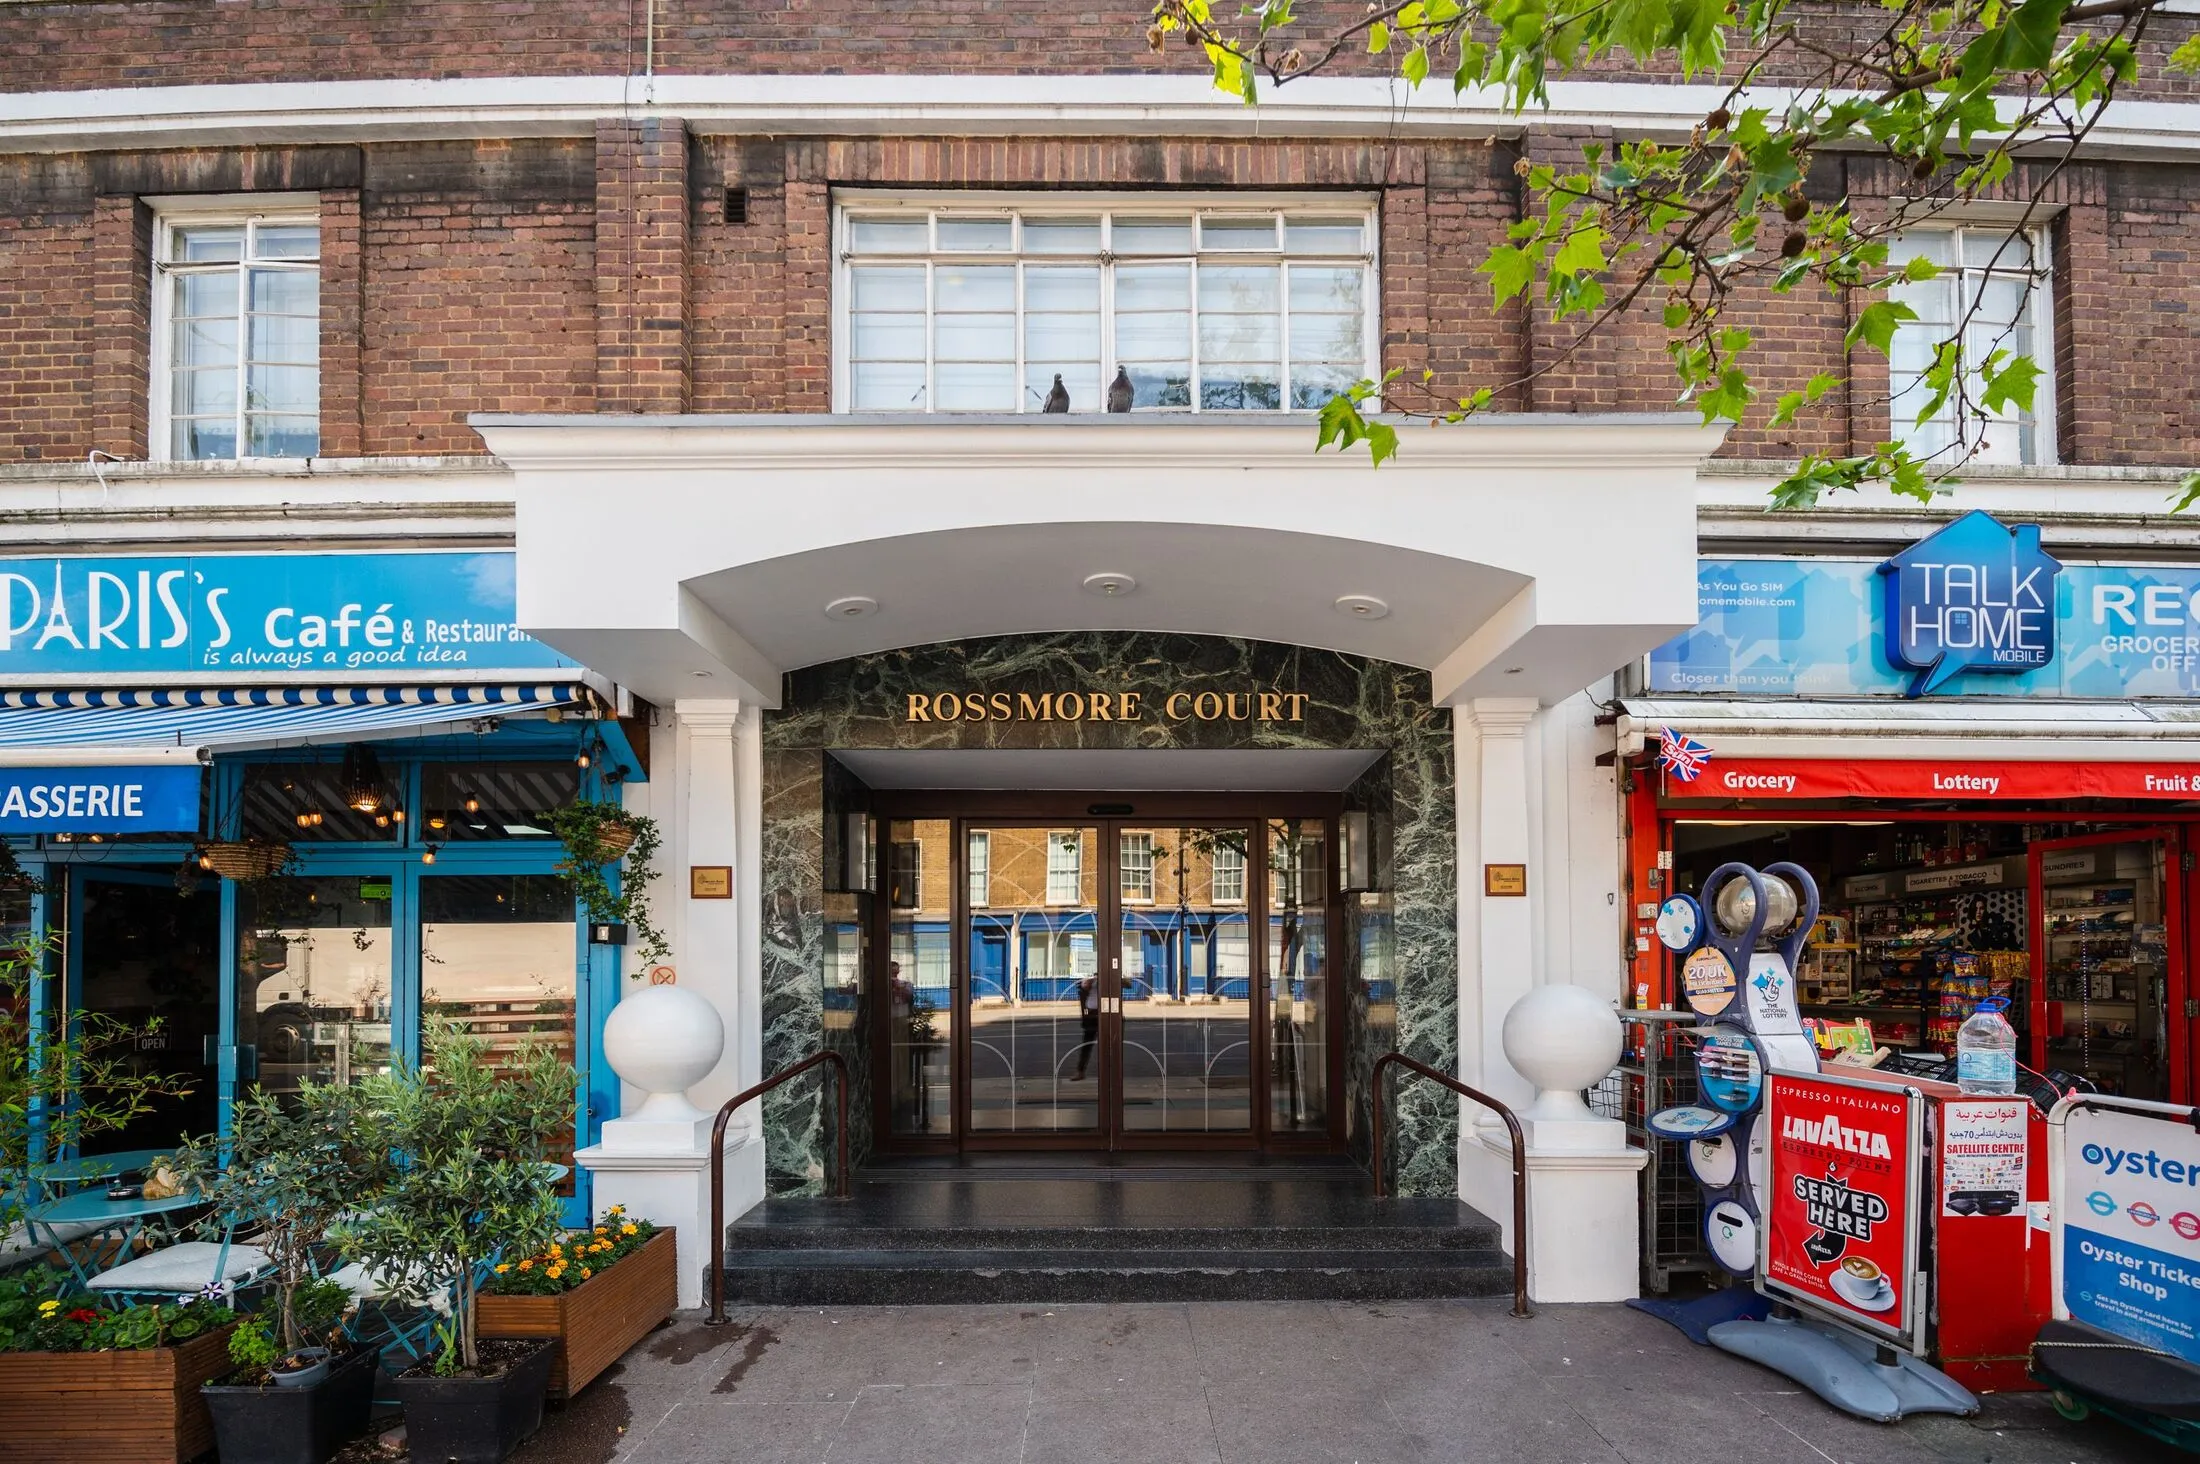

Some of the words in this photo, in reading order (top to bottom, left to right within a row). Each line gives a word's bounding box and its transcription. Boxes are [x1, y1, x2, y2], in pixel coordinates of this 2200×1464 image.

[1713, 583, 1736, 592] You
[1741, 583, 1757, 592] Go
[1761, 583, 1783, 592] SIM
[1911, 563, 2044, 608] TALK
[0, 559, 231, 650] PARIS's
[402, 619, 414, 643] &
[2092, 585, 2200, 626] RE
[1911, 606, 2046, 650] HOME
[204, 647, 220, 665] is
[230, 647, 313, 669] always
[323, 651, 337, 663] a
[345, 646, 406, 668] good
[417, 645, 468, 663] idea
[1994, 650, 2045, 663] MOBILE
[2152, 655, 2196, 673] OFF
[1671, 673, 1718, 684] Closer
[1724, 673, 1756, 685] than
[1762, 675, 1789, 686] you
[1795, 673, 1831, 686] think
[906, 692, 1142, 722] ROSSMORE
[1165, 692, 1309, 722] COURT
[1724, 772, 1796, 793] Grocery
[1933, 773, 2000, 794] Lottery
[2145, 775, 2188, 791] Fruit
[0, 784, 144, 818] ASSERIE
[1689, 966, 1706, 979] 20
[1708, 964, 1727, 978] UK
[142, 1038, 166, 1050] OPEN
[1776, 1085, 1831, 1103] ESPRESSO
[1836, 1096, 1901, 1114] ITALIANO
[1783, 1114, 1892, 1160] LAVAZZA
[1946, 1144, 1990, 1154] SATELLITE
[1992, 1144, 2025, 1153] CENTRE
[1782, 1141, 1841, 1161] ESPRESSO
[1849, 1156, 1893, 1173] POINT
[1796, 1178, 1884, 1219] SERVED
[1810, 1202, 1868, 1238] HERE
[2080, 1240, 2144, 1270] Oyster
[2119, 1272, 2168, 1301] Shop
[2094, 1300, 2115, 1312] travel
[2116, 1306, 2123, 1314] in
[2124, 1310, 2140, 1319] and
[2140, 1315, 2165, 1329] around
[2166, 1324, 2194, 1339] London
[2096, 1293, 2108, 1303] Get
[2119, 1301, 2144, 1315] Oyster
[2144, 1309, 2161, 1320] card
[2162, 1316, 2180, 1327] here
[2181, 1322, 2192, 1331] for
